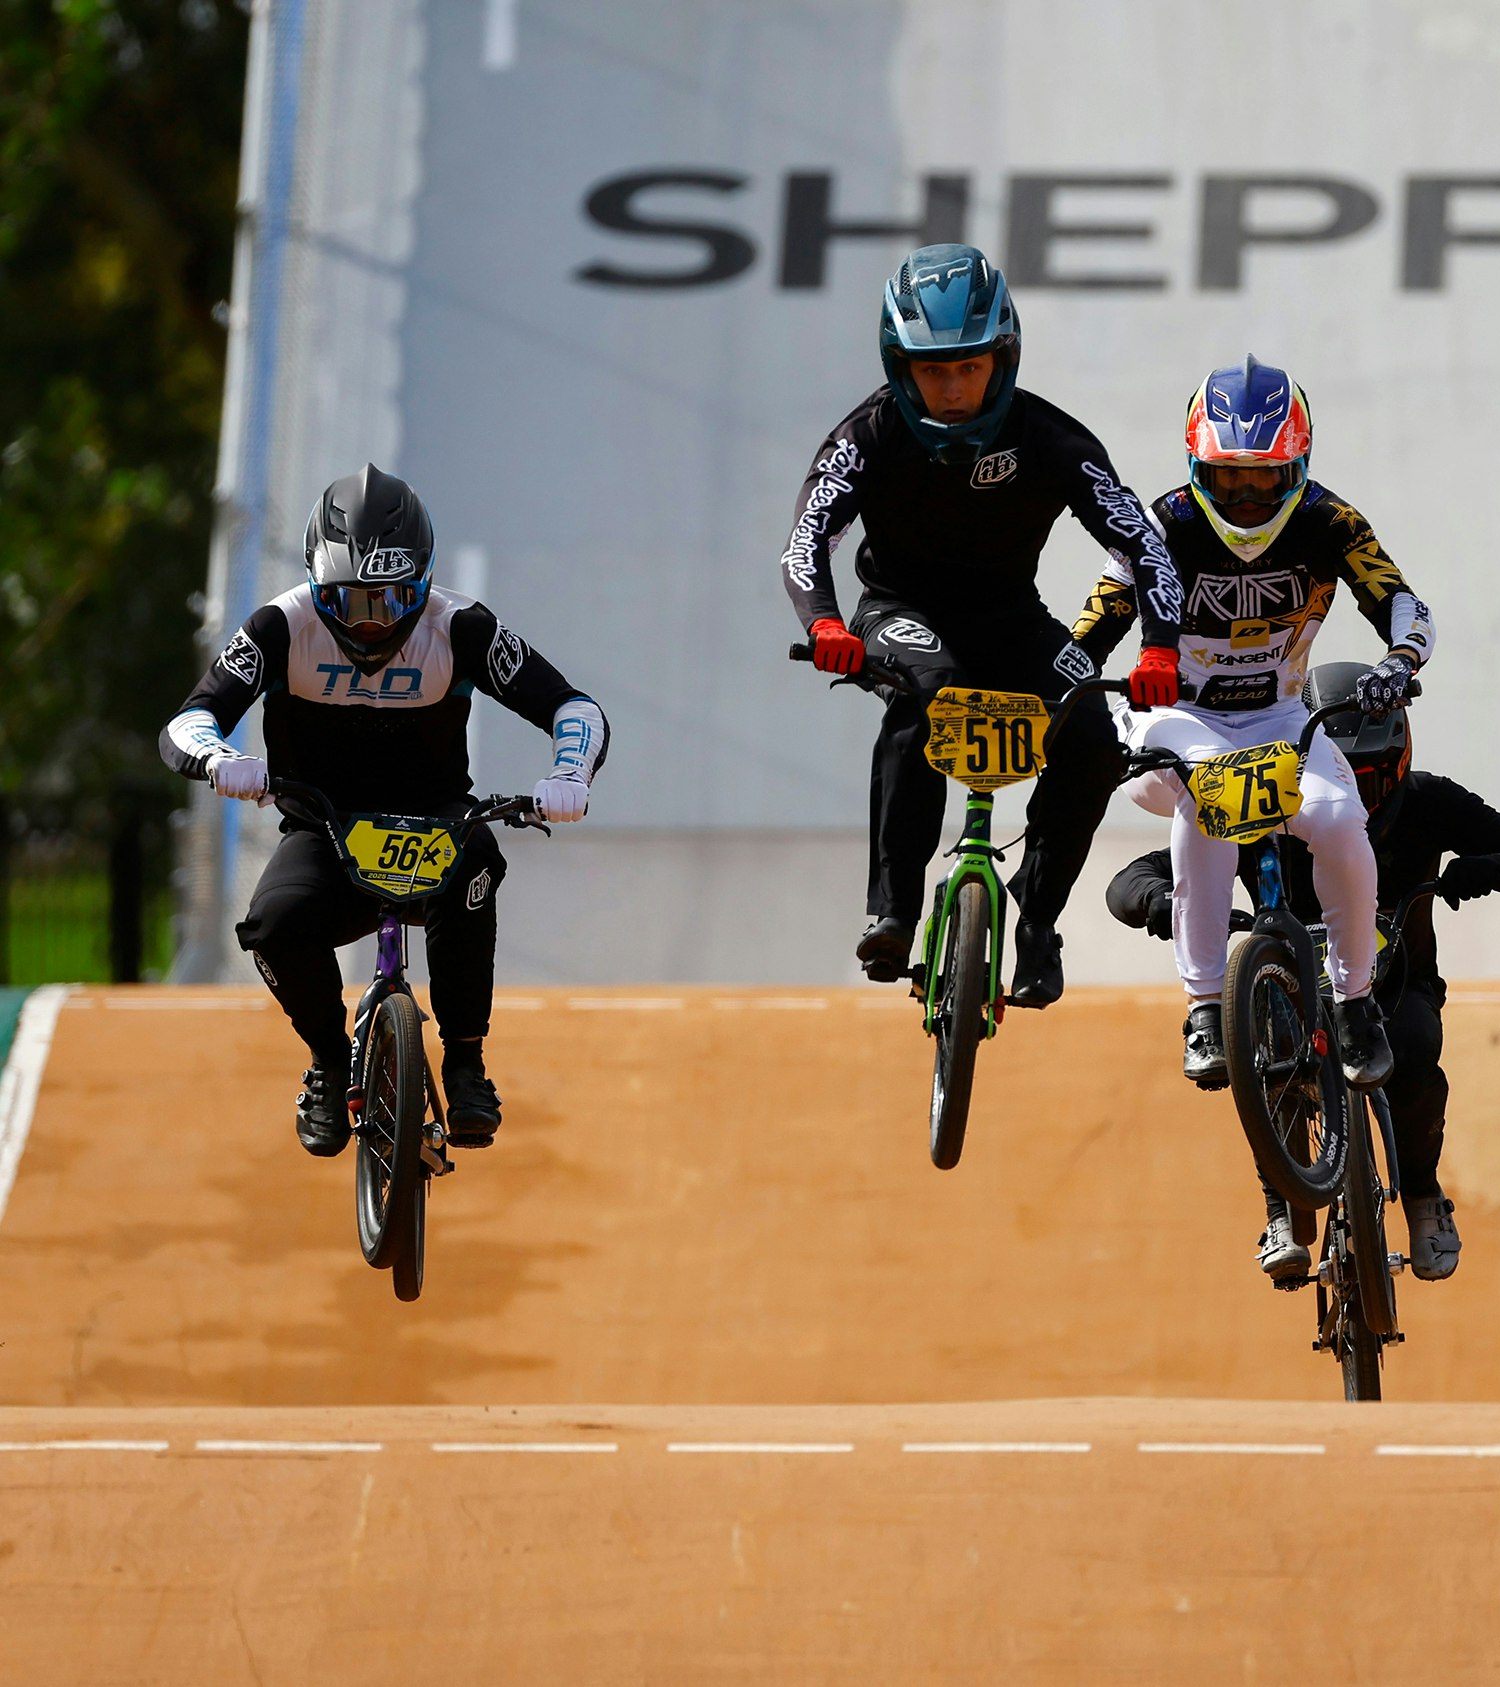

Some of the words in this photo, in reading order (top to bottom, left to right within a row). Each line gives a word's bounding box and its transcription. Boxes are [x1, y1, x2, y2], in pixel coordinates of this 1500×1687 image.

[1214, 644, 1283, 666] TANGENT
[316, 663, 423, 700] TLD
[1225, 690, 1268, 701] LEAD
[966, 717, 1034, 774] 510
[1233, 761, 1280, 821] 75
[378, 833, 423, 871] 56
[367, 872, 387, 880] 2025
